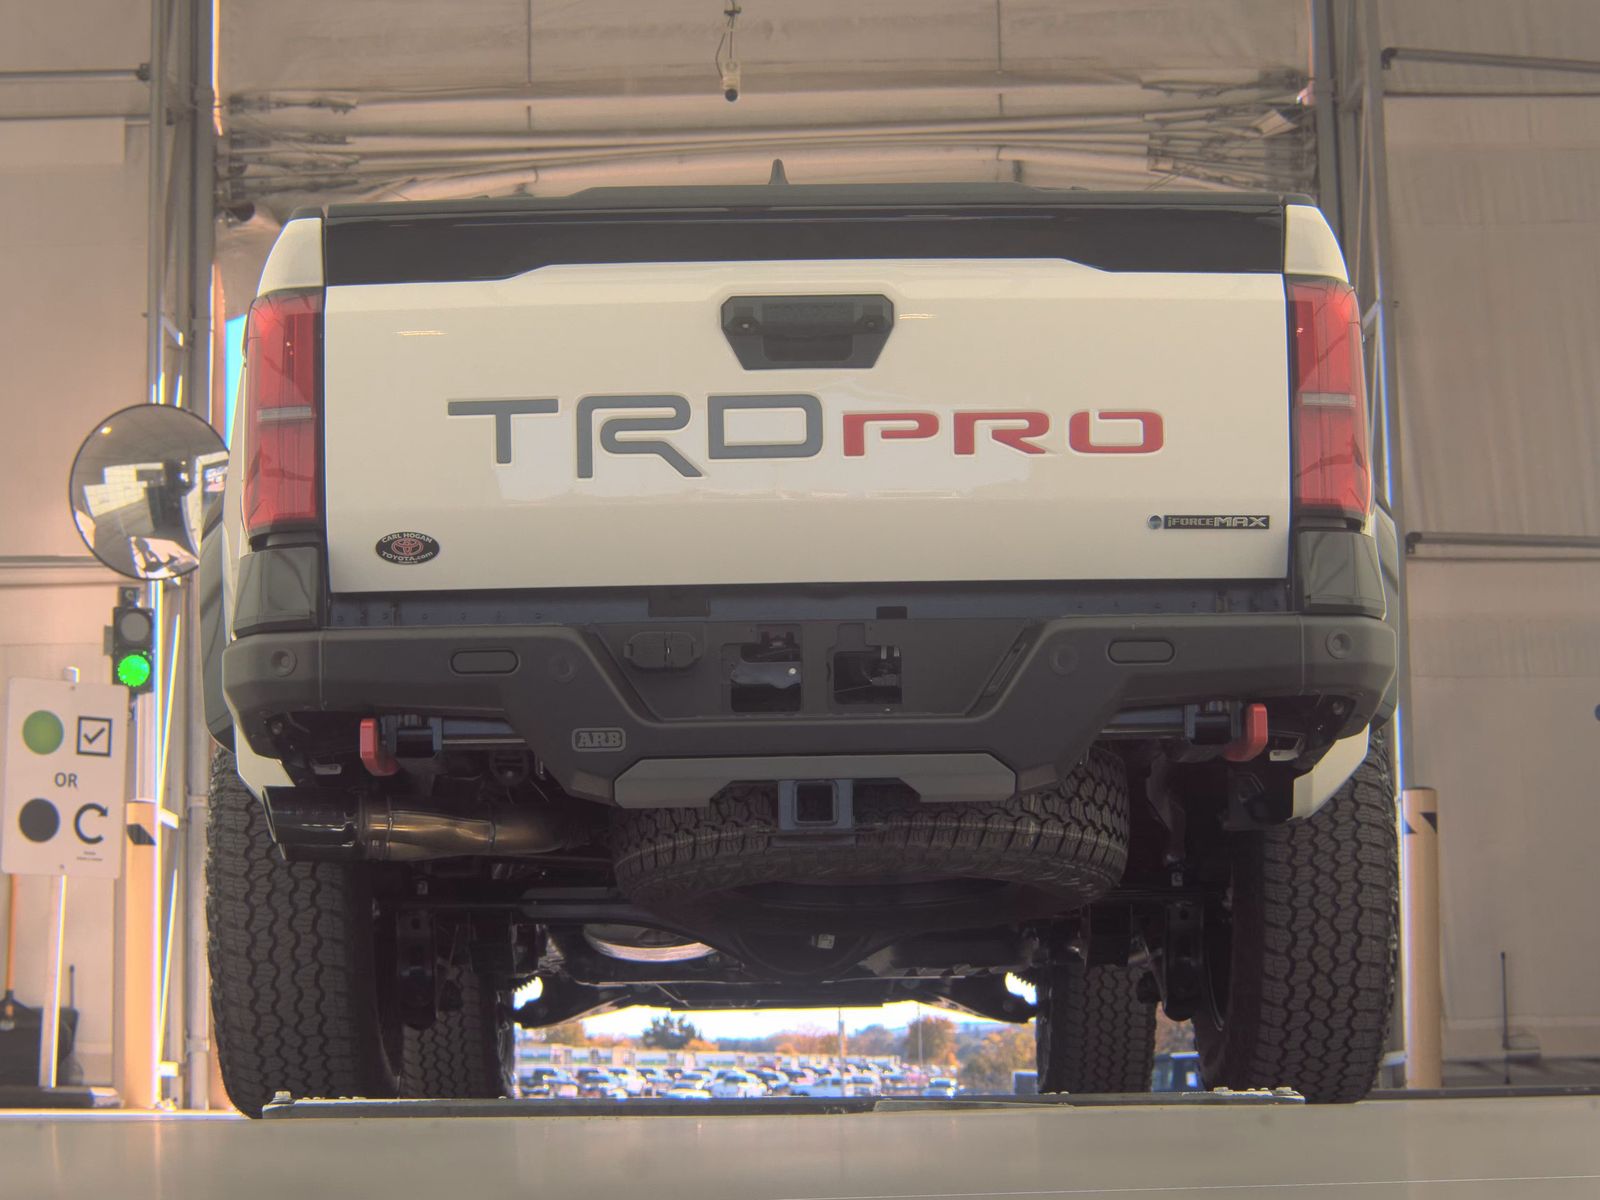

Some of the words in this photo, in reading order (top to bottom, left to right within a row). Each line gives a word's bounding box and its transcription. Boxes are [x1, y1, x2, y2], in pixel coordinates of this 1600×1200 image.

[448, 394, 823, 479] TRD
[843, 409, 1165, 457] PRO
[382, 533, 402, 543] CARL
[403, 533, 433, 543] HOGAN
[382, 551, 433, 561] TOYOTA.com
[577, 731, 621, 748] ARB
[54, 772, 78, 788] OR
